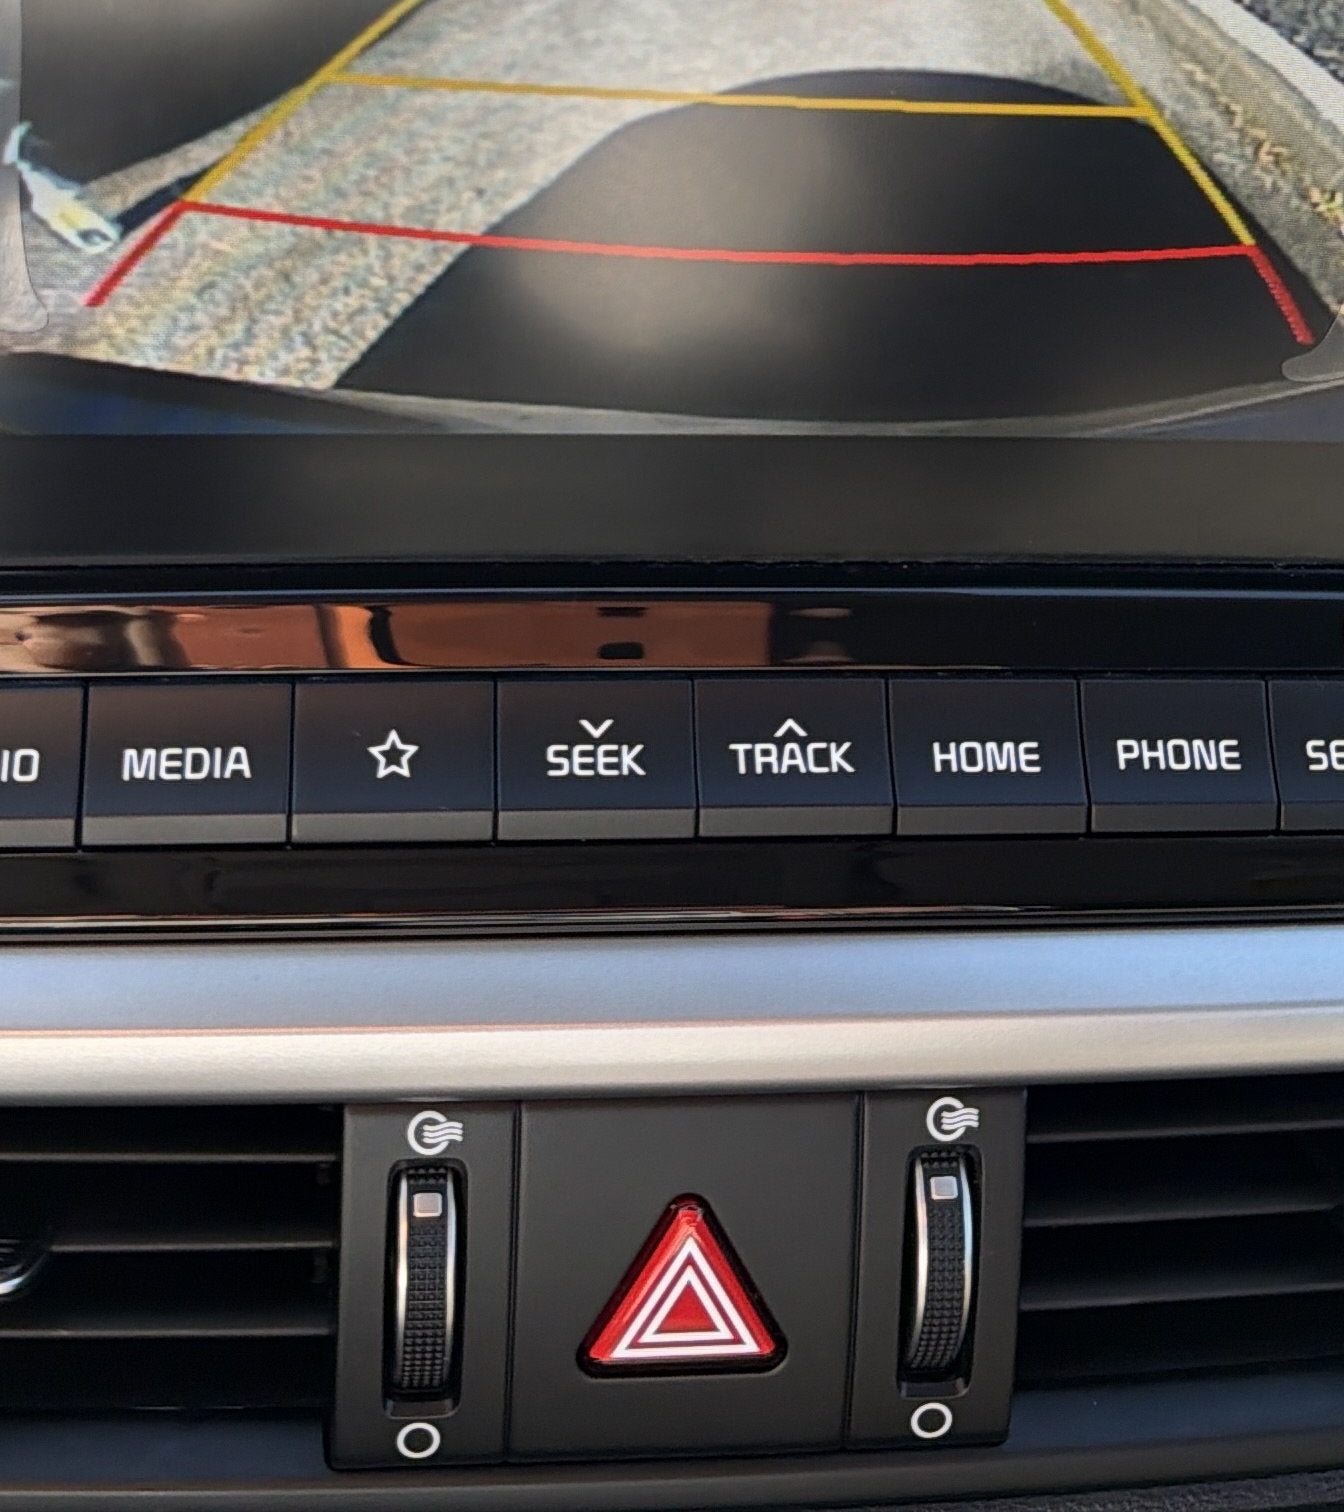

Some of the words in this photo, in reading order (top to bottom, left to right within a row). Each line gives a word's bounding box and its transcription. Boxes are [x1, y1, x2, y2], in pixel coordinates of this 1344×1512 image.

[122, 746, 252, 782] MEDIA
[546, 744, 646, 777] SEEK
[728, 742, 856, 775] TRACK
[932, 741, 1042, 773] HOME
[1116, 738, 1242, 771] PHONE
